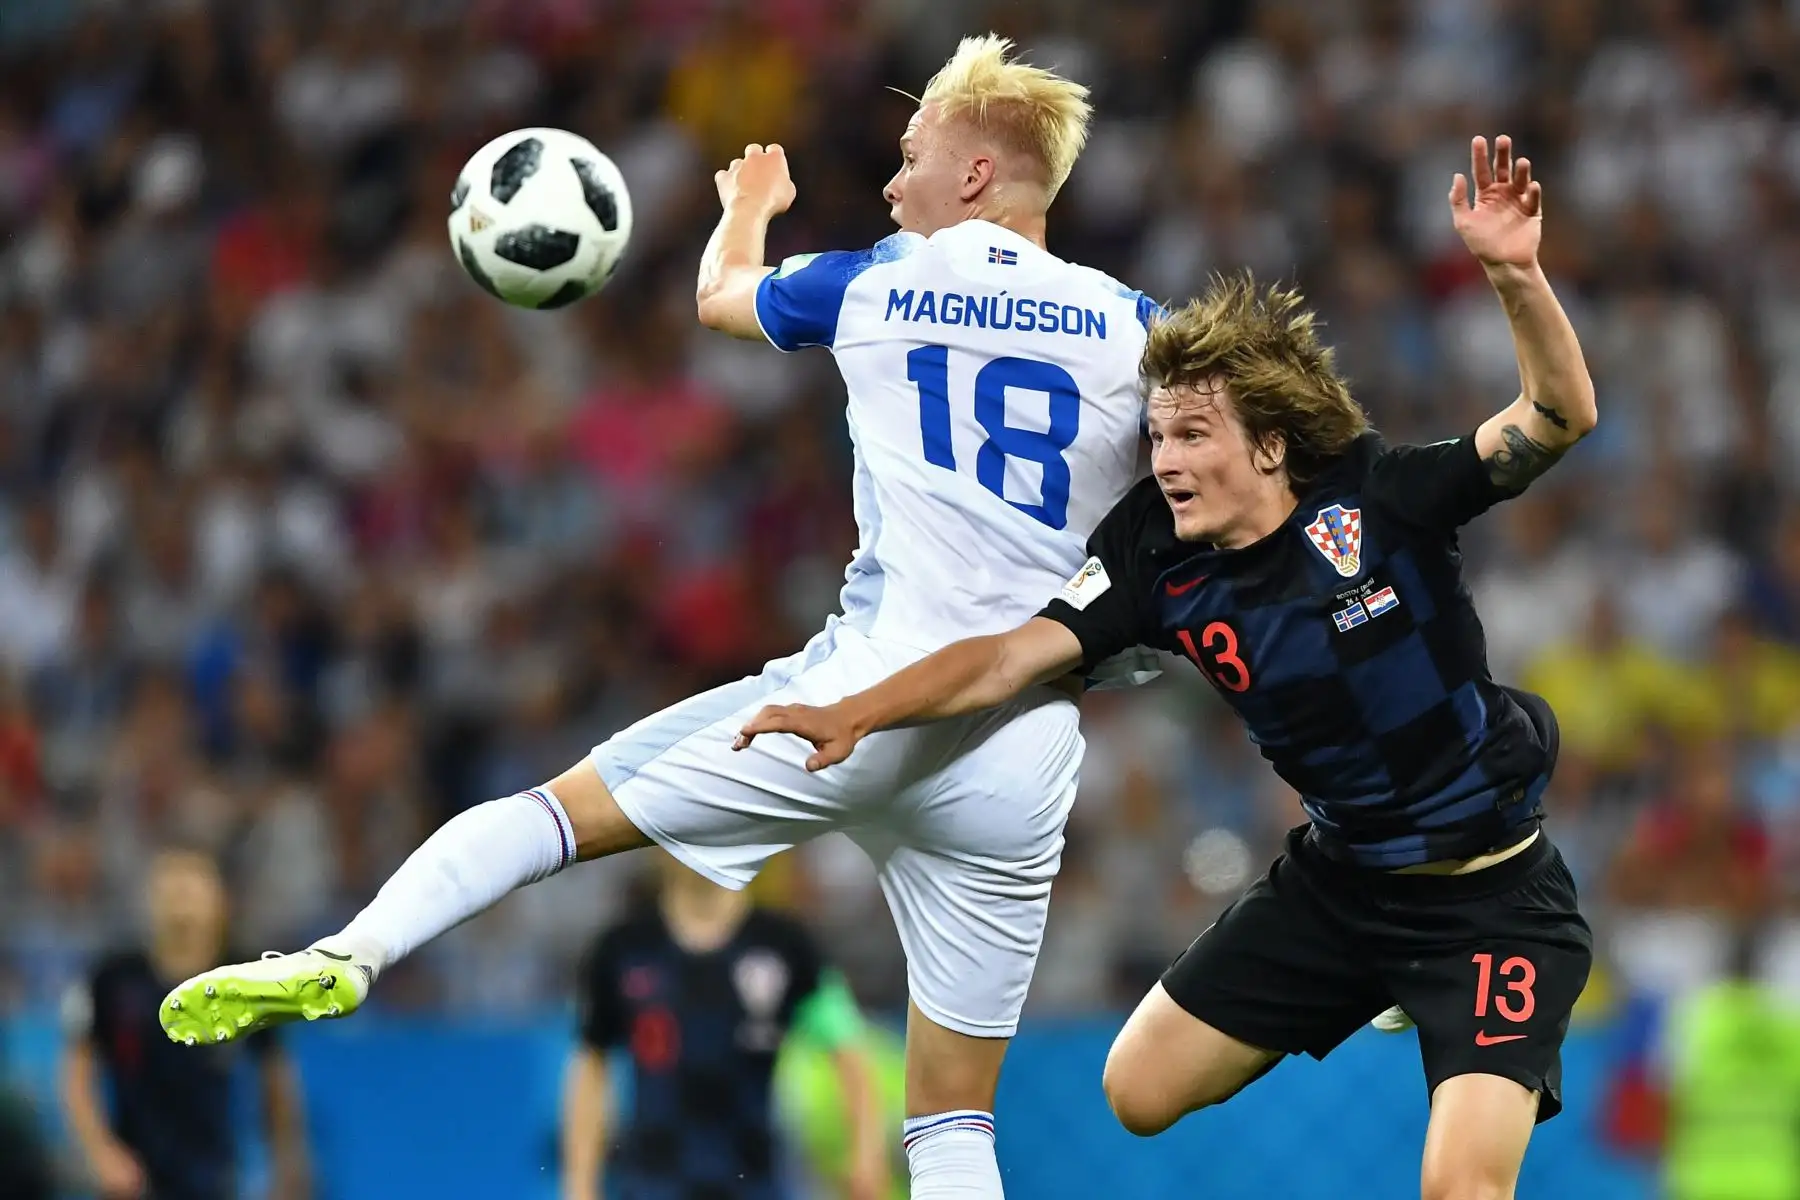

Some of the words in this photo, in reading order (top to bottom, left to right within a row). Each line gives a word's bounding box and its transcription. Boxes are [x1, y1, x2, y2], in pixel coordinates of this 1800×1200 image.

[884, 290, 1107, 340] MAGNÚSSON
[907, 344, 1081, 531] 18
[1176, 621, 1250, 692] 13
[1471, 953, 1537, 1023] 13
